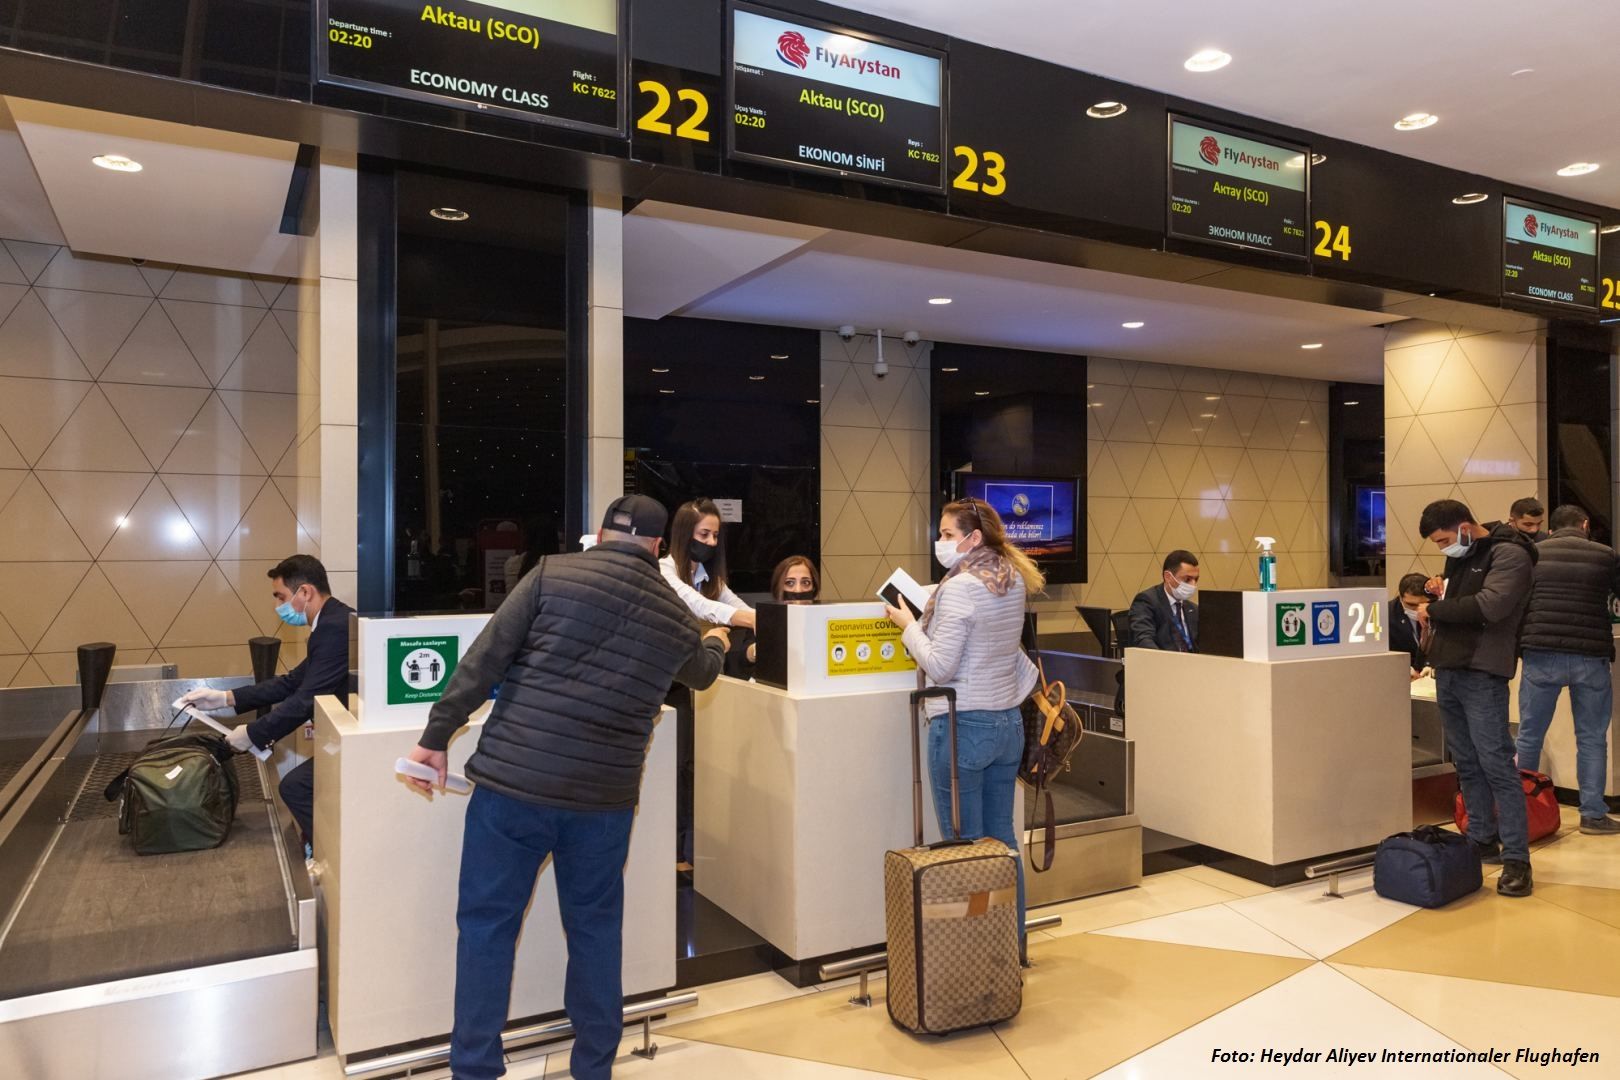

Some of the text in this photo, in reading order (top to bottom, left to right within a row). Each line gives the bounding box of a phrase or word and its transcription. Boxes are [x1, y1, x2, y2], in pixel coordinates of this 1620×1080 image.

[328, 18, 368, 33] Departure
[370, 27, 387, 37] time
[421, 5, 540, 49] Aktau (SCO)
[329, 29, 372, 48] 02:20
[815, 46, 901, 79] FlyArystan
[572, 70, 592, 81] Flight
[410, 69, 549, 108] ECONOMY CLASS
[572, 82, 617, 100] KC 7622
[637, 80, 710, 143] 22
[799, 89, 885, 122] Aktau (SCO)
[735, 113, 766, 128] 02:20
[799, 145, 885, 171] EKONOM SİNFİ
[908, 149, 940, 163] KC 7622
[1224, 147, 1280, 171] FlyArystan
[953, 146, 1007, 195] 23
[1213, 181, 1269, 206] Актау (SCO)
[1172, 202, 1192, 214] 02:20
[1208, 225, 1272, 246] ЭКОНОМ КЛАСС
[1283, 226, 1292, 234] KC
[1540, 223, 1579, 240] FlyArystan
[1314, 220, 1351, 261] 24
[1532, 250, 1571, 269] Aktau (SCO)
[1528, 286, 1574, 301] ECONOMY CLASS
[829, 622, 873, 632] Coronavirus
[1348, 601, 1382, 643] 24
